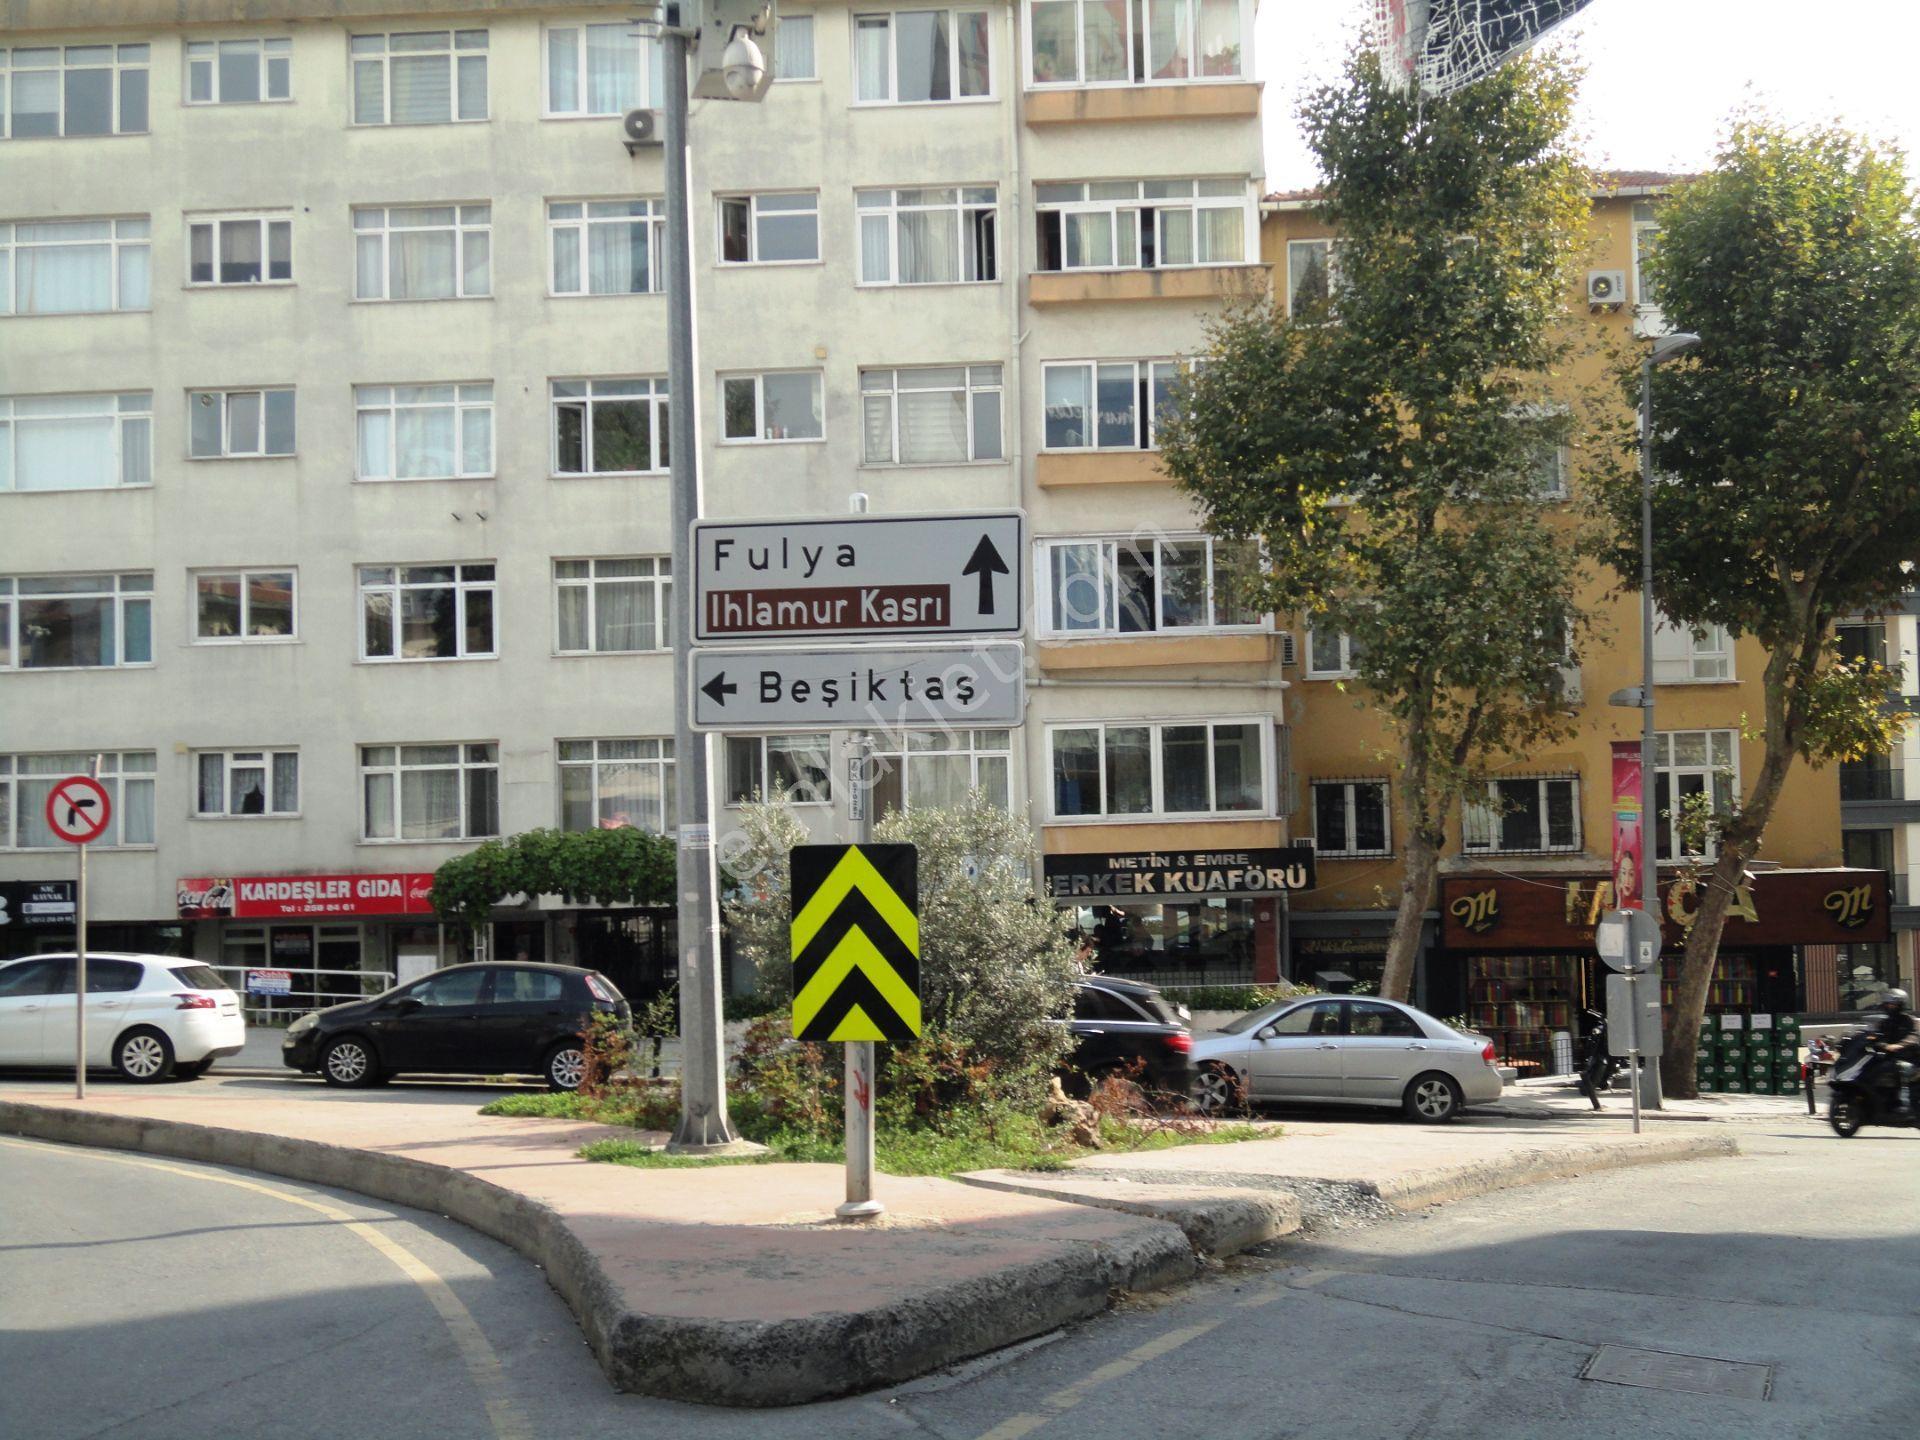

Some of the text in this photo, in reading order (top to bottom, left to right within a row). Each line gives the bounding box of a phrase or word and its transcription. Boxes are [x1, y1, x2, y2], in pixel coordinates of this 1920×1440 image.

[714, 537, 856, 579] Fulya
[712, 589, 942, 627] Ihlamur Kasrı
[759, 669, 975, 707] Beşiktaş
[1108, 852, 1250, 869] METİN & EMRE
[240, 879, 403, 904] KARDEŞLER GIDA
[1052, 863, 1307, 897] ERKEK KUAFÖRÜ
[1565, 879, 1760, 926] MCA
